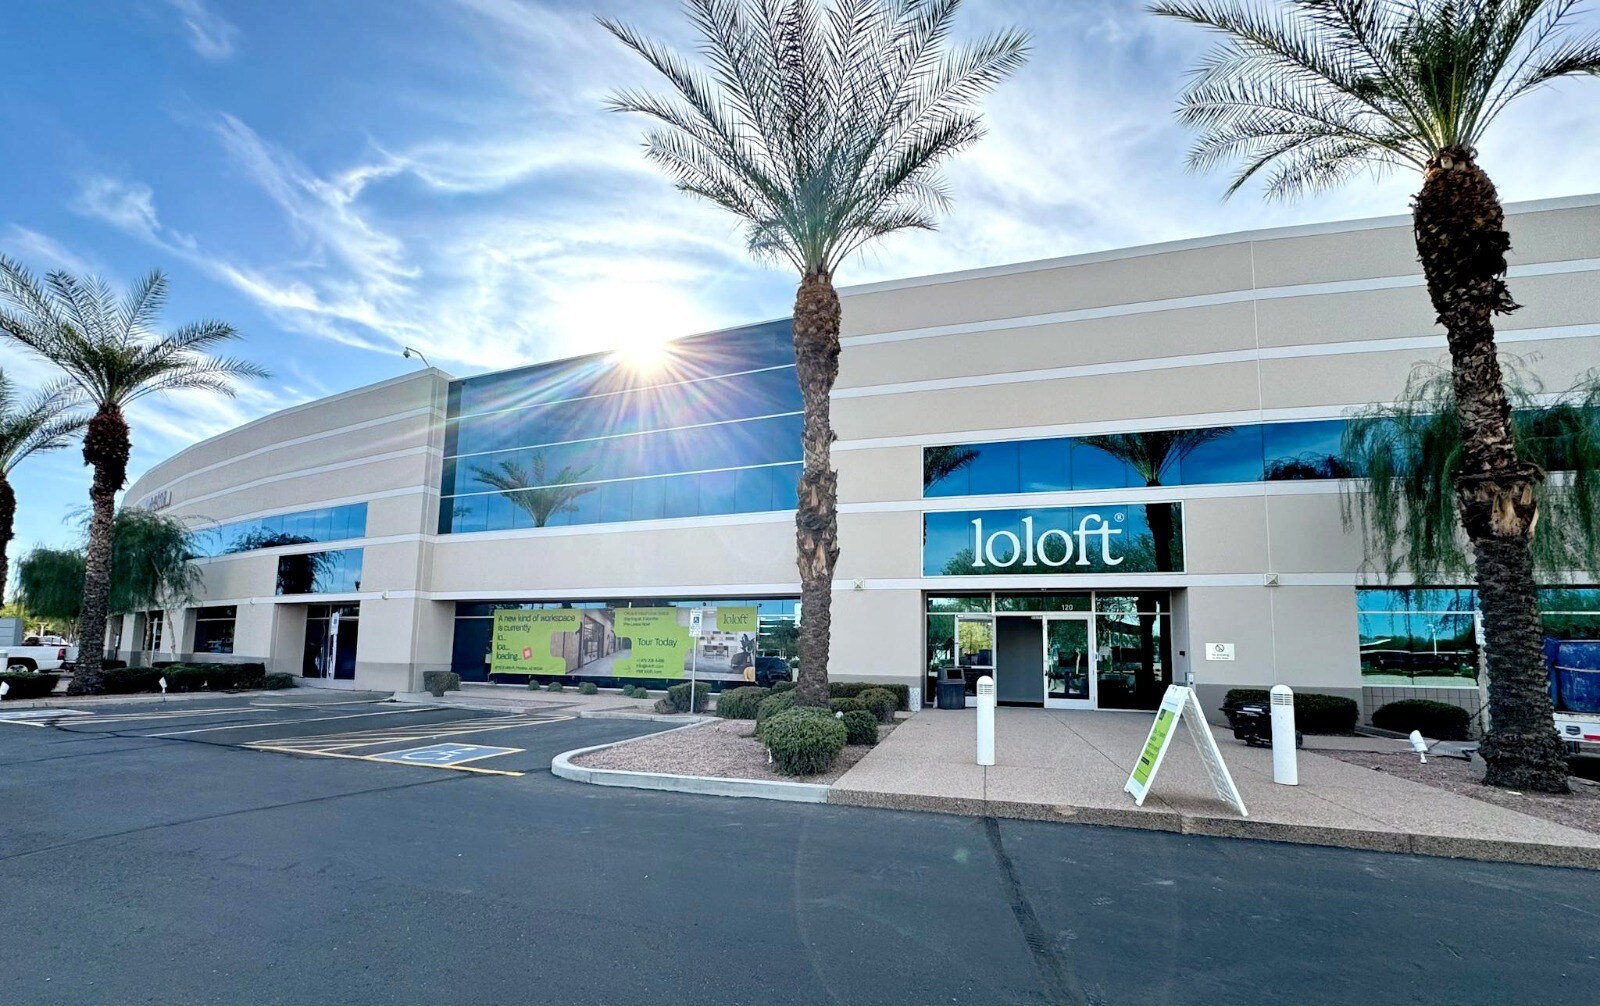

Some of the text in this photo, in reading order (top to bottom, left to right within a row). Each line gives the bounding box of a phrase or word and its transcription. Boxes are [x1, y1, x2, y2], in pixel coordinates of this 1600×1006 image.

[518, 614, 532, 622] kind
[532, 614, 540, 622] of
[540, 615, 576, 623] workspace
[504, 624, 531, 633] currently
[637, 637, 678, 648] Tour Today
